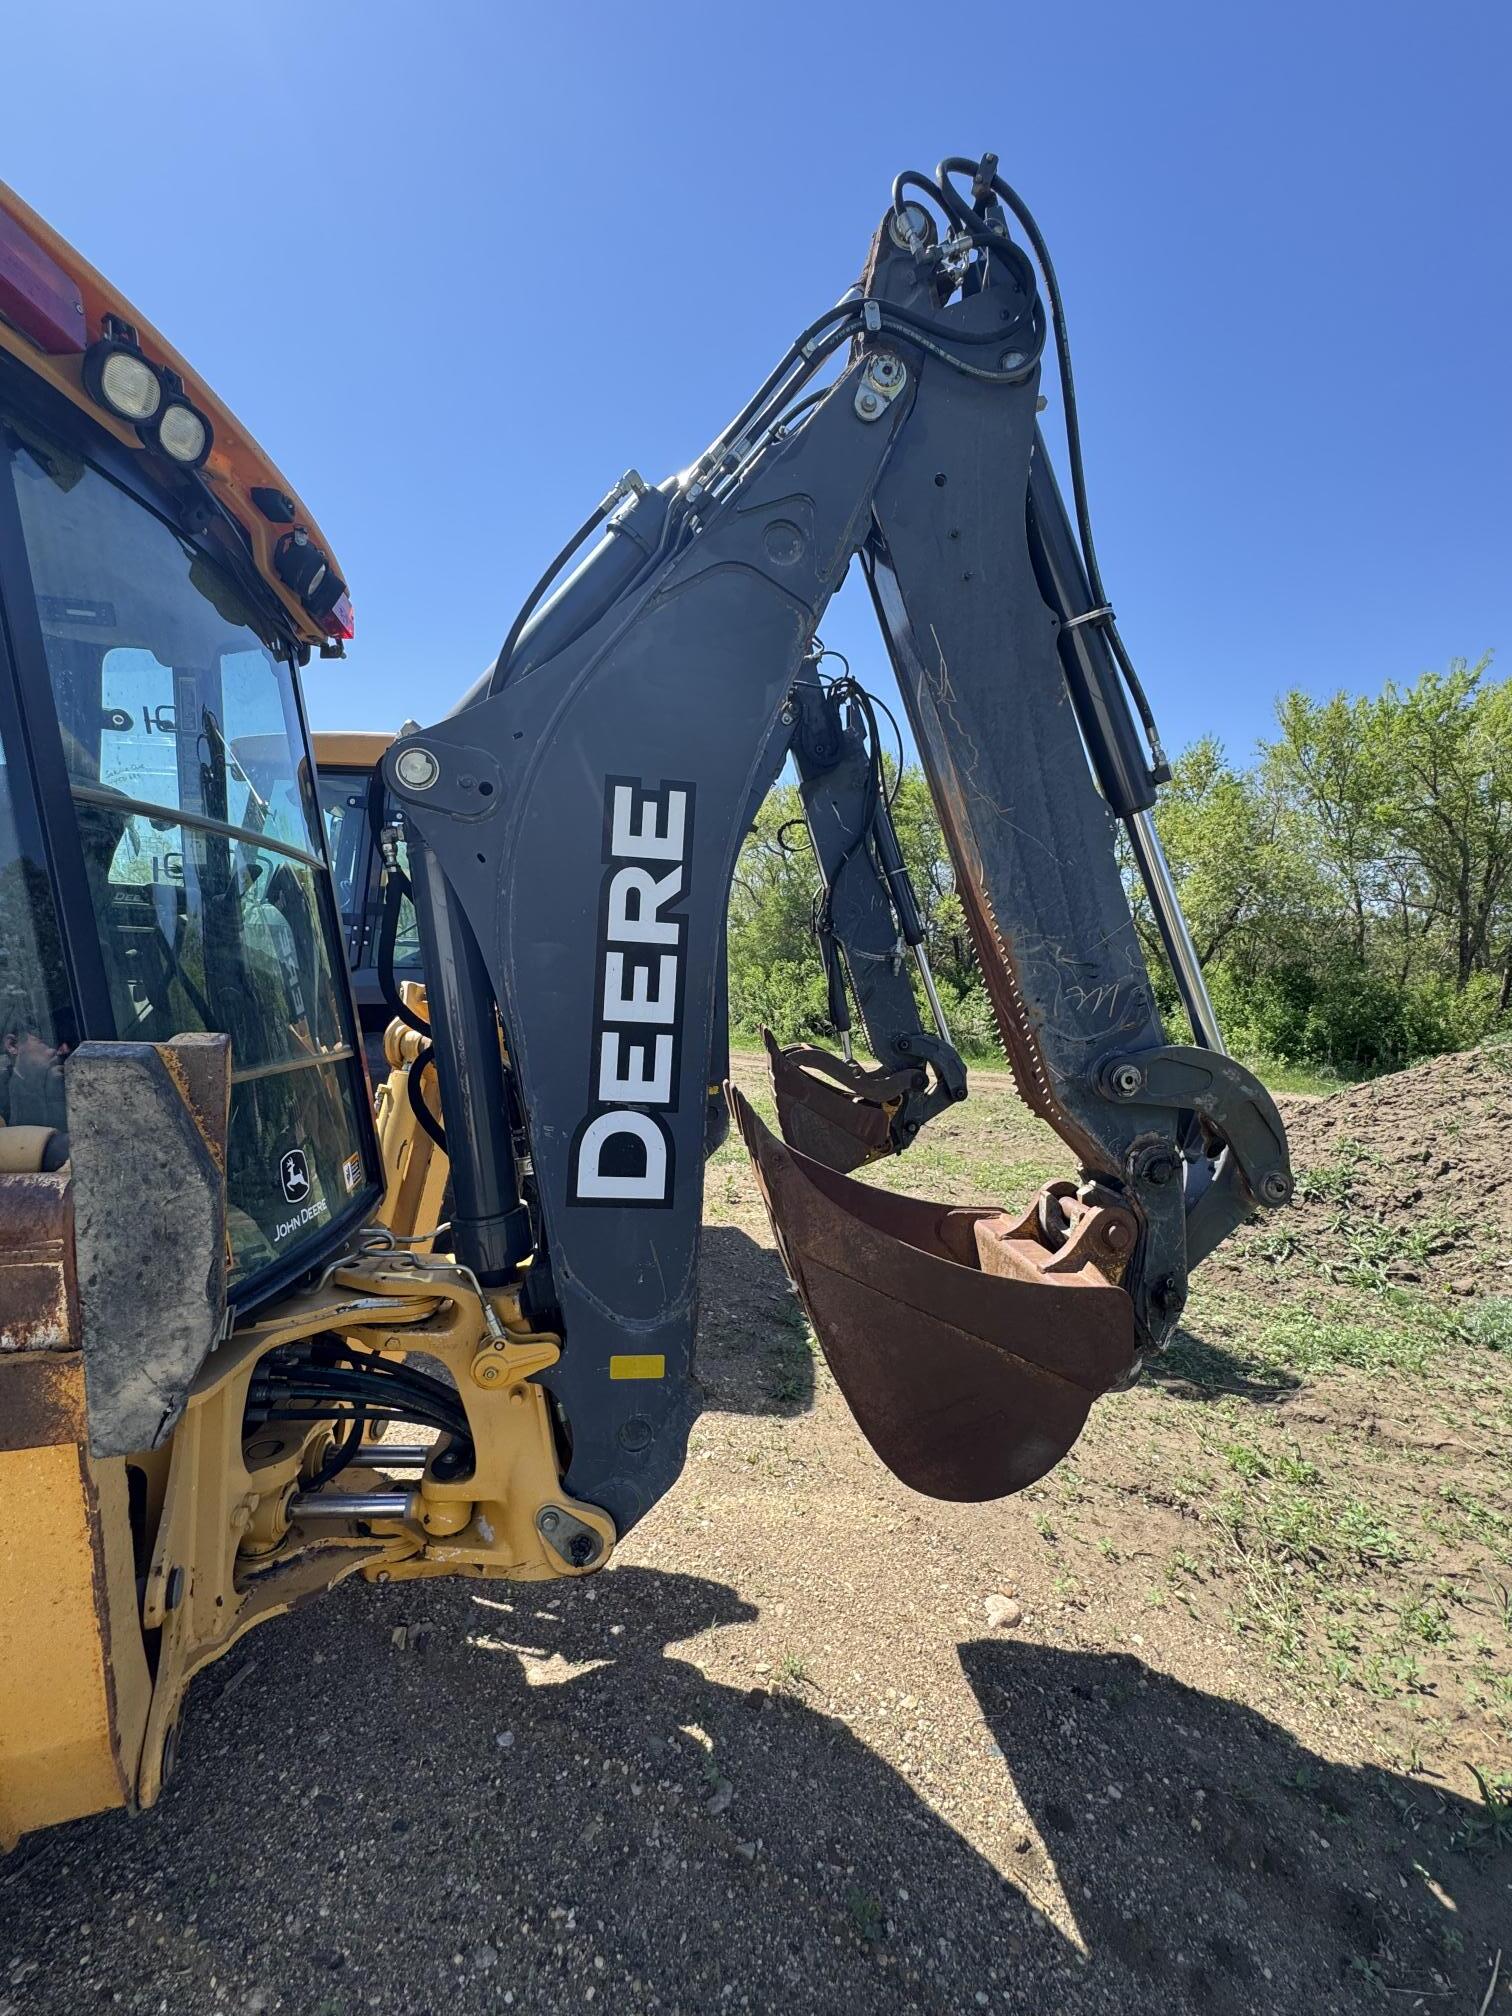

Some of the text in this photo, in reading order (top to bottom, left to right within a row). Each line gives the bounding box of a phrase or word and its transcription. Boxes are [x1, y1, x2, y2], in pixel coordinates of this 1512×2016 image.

[577, 785, 687, 1200] DEERE
[274, 1198, 328, 1242] JOHN DEERE
